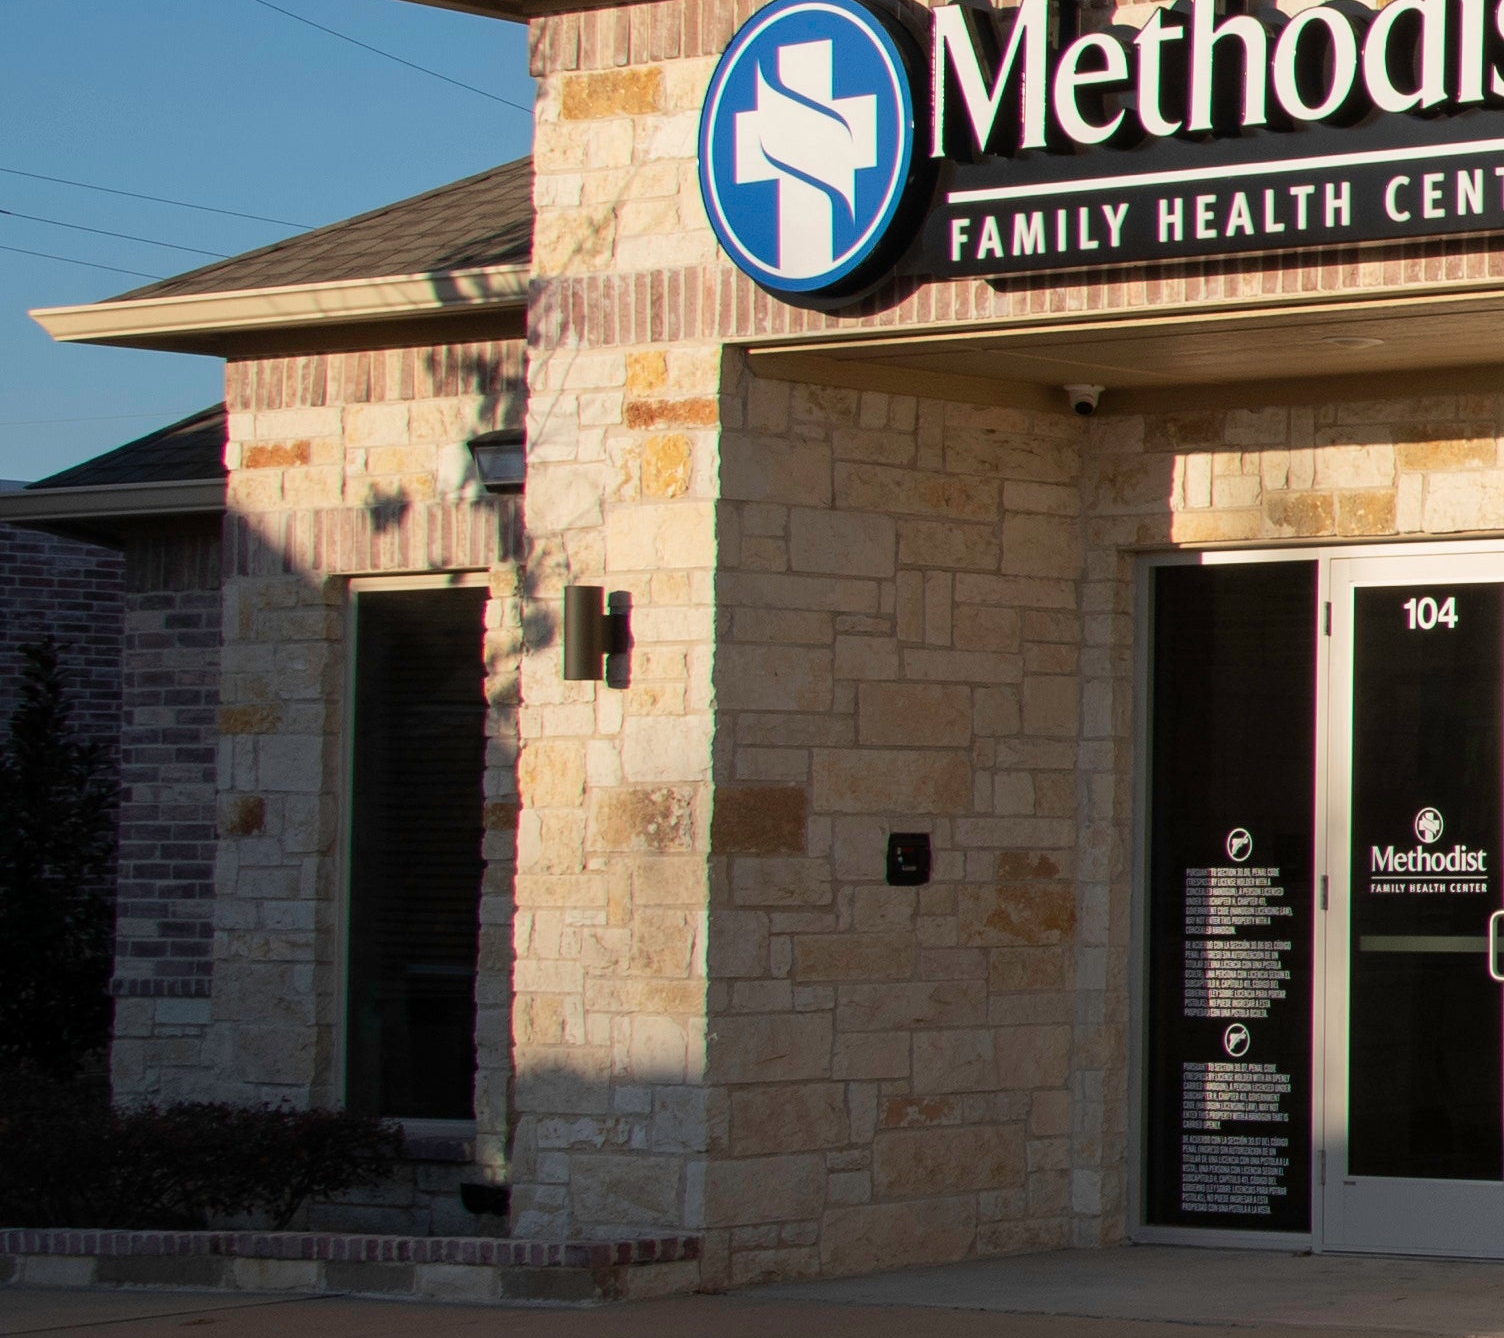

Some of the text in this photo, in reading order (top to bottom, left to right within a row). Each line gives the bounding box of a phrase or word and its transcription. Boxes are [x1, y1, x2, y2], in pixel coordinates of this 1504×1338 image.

[951, 203, 1130, 263] FAMILY
[1158, 181, 1352, 244] HEALTH
[1403, 596, 1459, 630] 104
[1370, 844, 1488, 872] Methodist
[1370, 883, 1488, 893] FAMILY HEALTH CENTER
